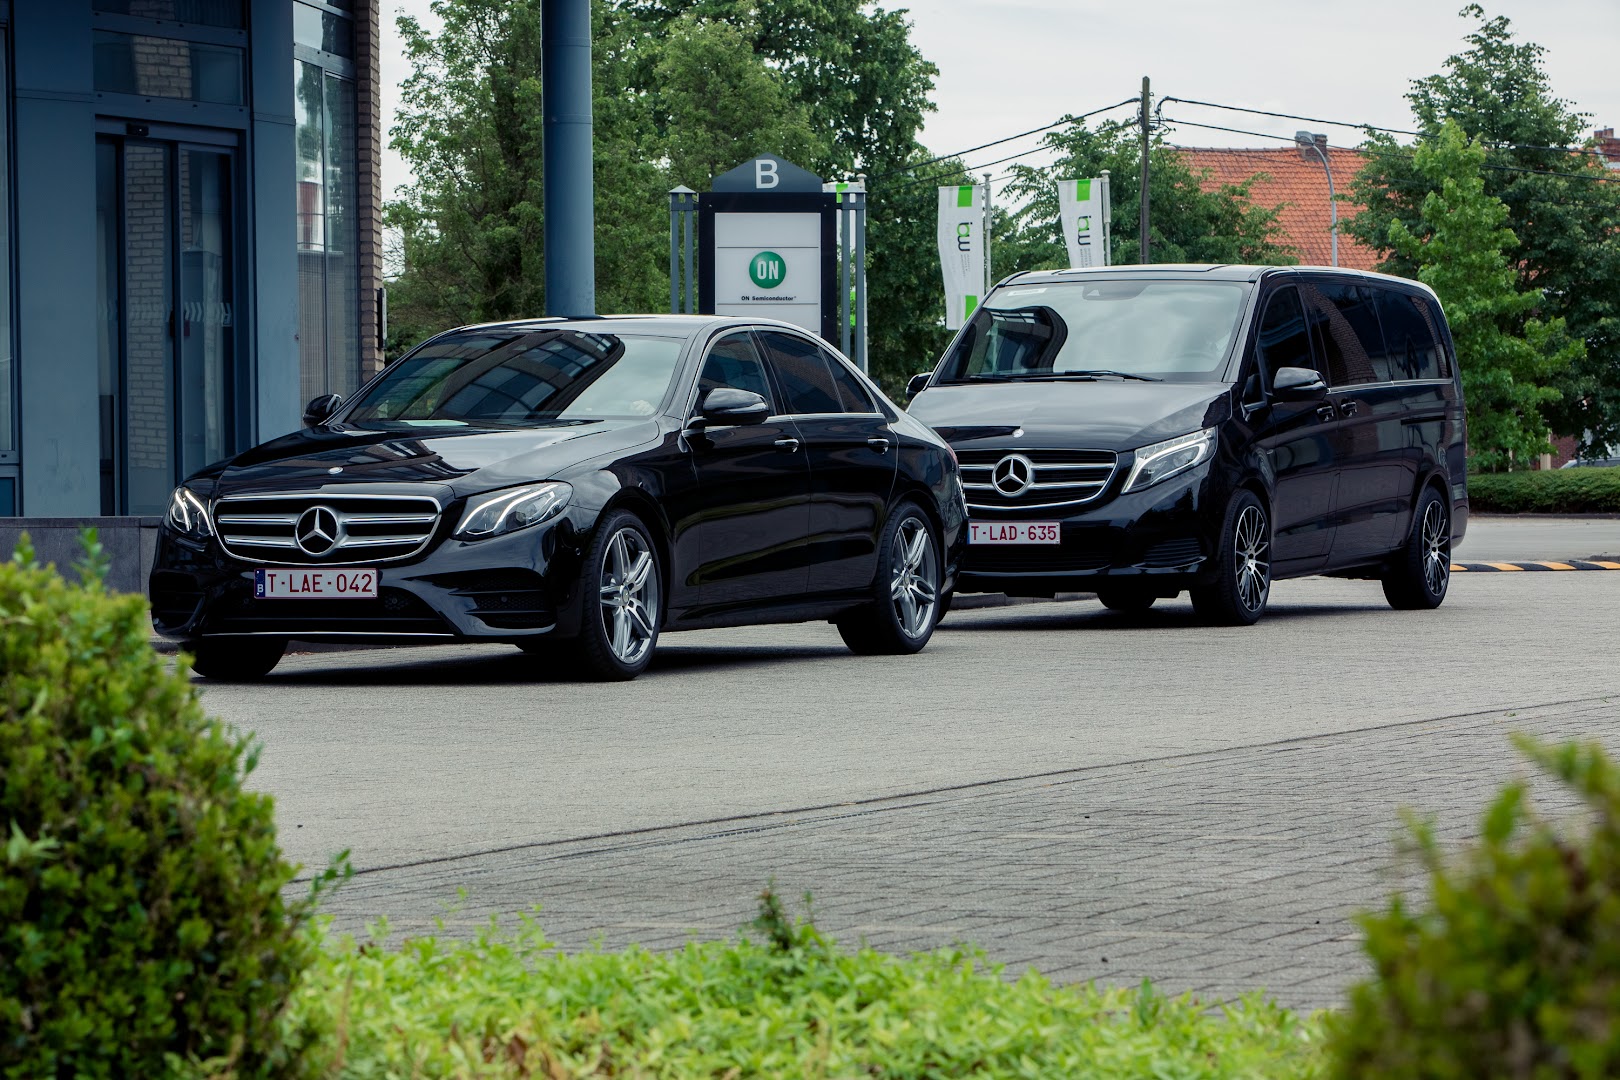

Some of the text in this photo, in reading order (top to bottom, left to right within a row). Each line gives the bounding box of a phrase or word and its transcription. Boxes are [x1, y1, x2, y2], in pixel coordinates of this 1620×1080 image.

[755, 159, 780, 189] B
[756, 260, 779, 280] ON
[971, 525, 1057, 541] T-LAD-635
[257, 584, 264, 593] B
[267, 573, 373, 593] T-LAE-042
